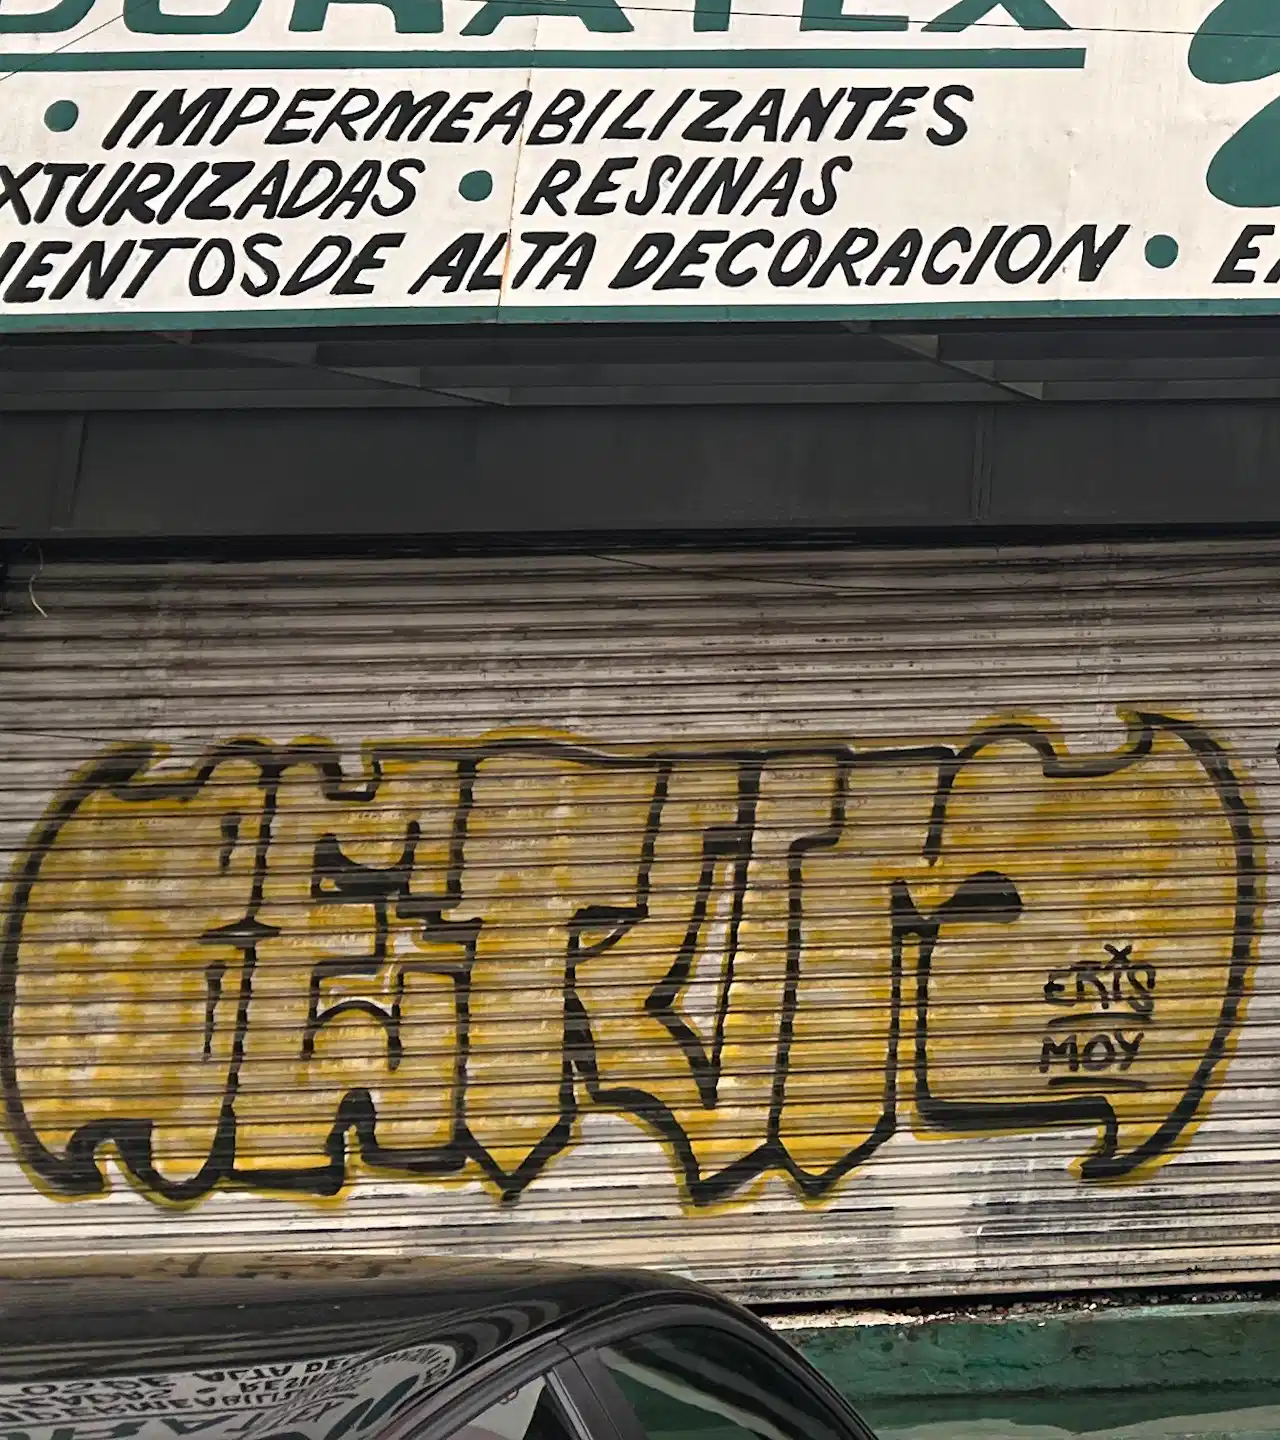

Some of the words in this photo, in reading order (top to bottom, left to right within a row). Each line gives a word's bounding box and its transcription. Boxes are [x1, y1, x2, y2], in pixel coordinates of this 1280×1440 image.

[102, 85, 974, 150] IMPERMEABILIZANTES
[0, 158, 425, 228] XTURIZADAS
[520, 155, 853, 217] RESINAS
[408, 230, 595, 295] ALTA
[608, 224, 1131, 290] DECORACION
[1039, 1029, 1145, 1074] MOY
